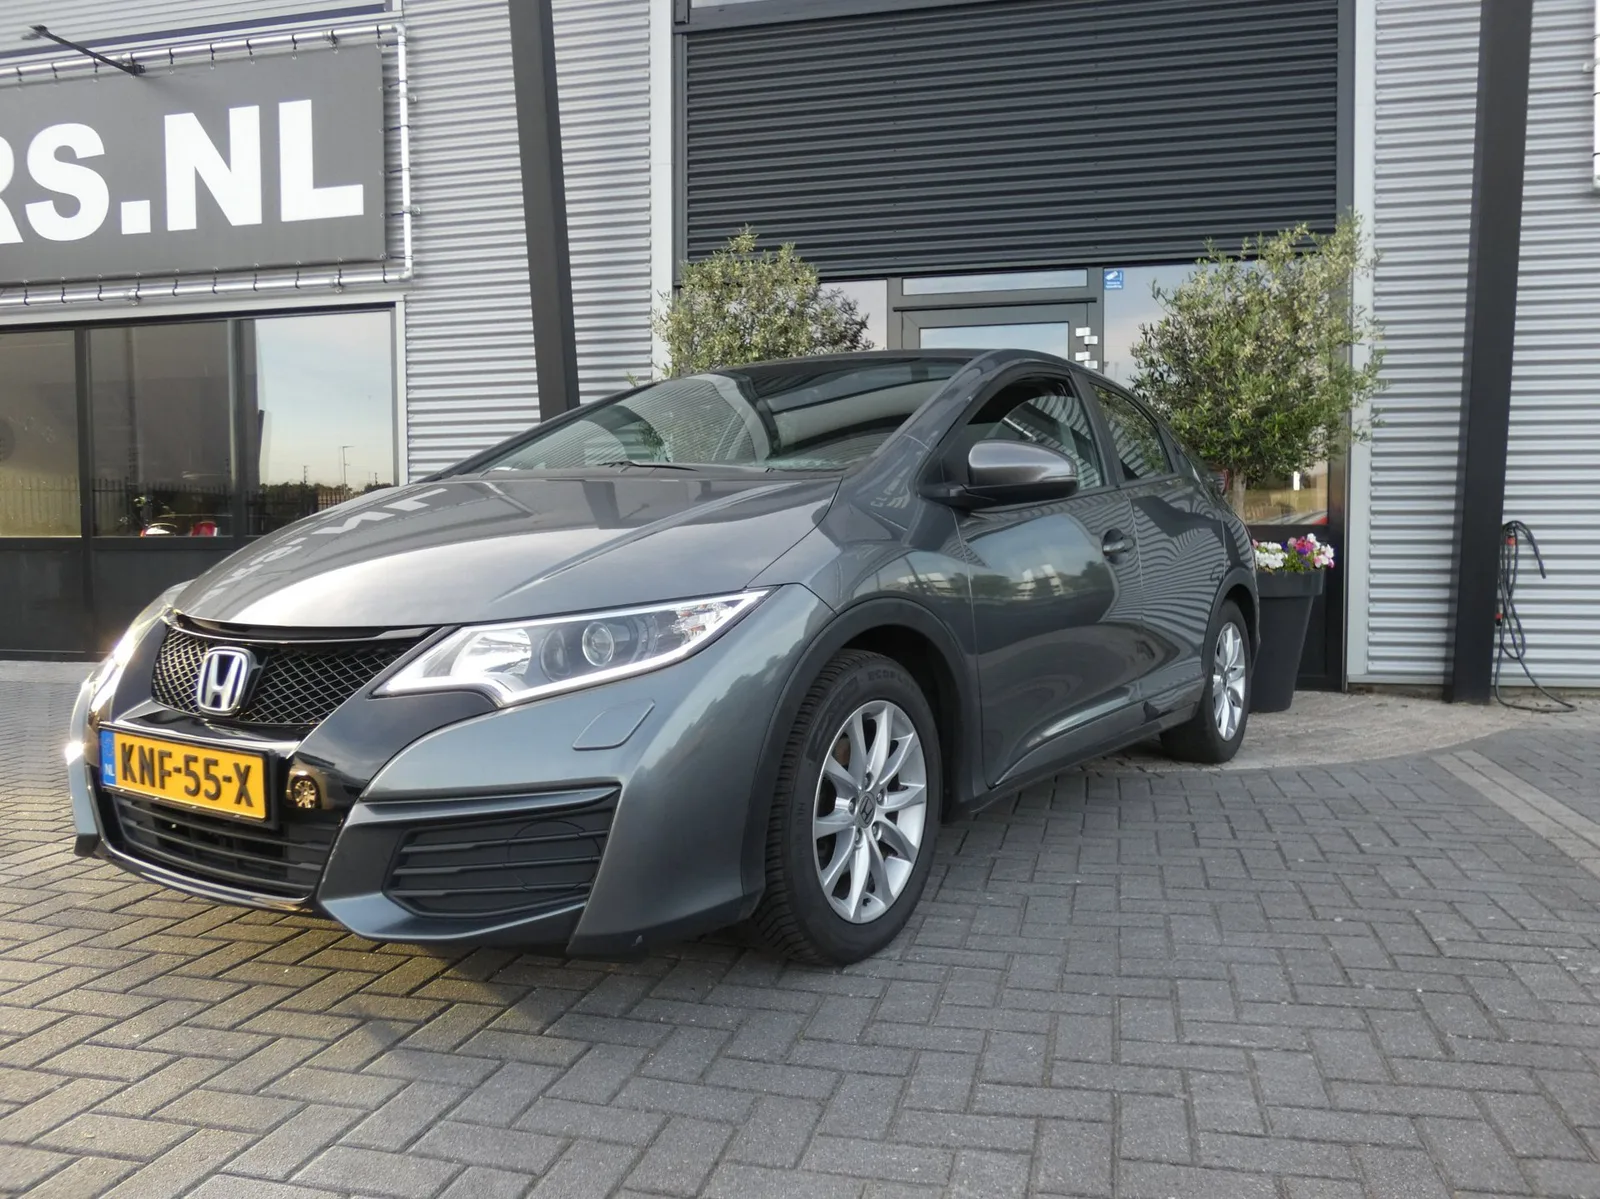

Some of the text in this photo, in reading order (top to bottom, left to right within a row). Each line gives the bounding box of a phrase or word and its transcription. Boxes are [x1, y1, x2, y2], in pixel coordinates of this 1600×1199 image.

[0, 99, 364, 245] S.NL
[104, 763, 116, 777] NL
[120, 742, 254, 808] KNF-55-X
